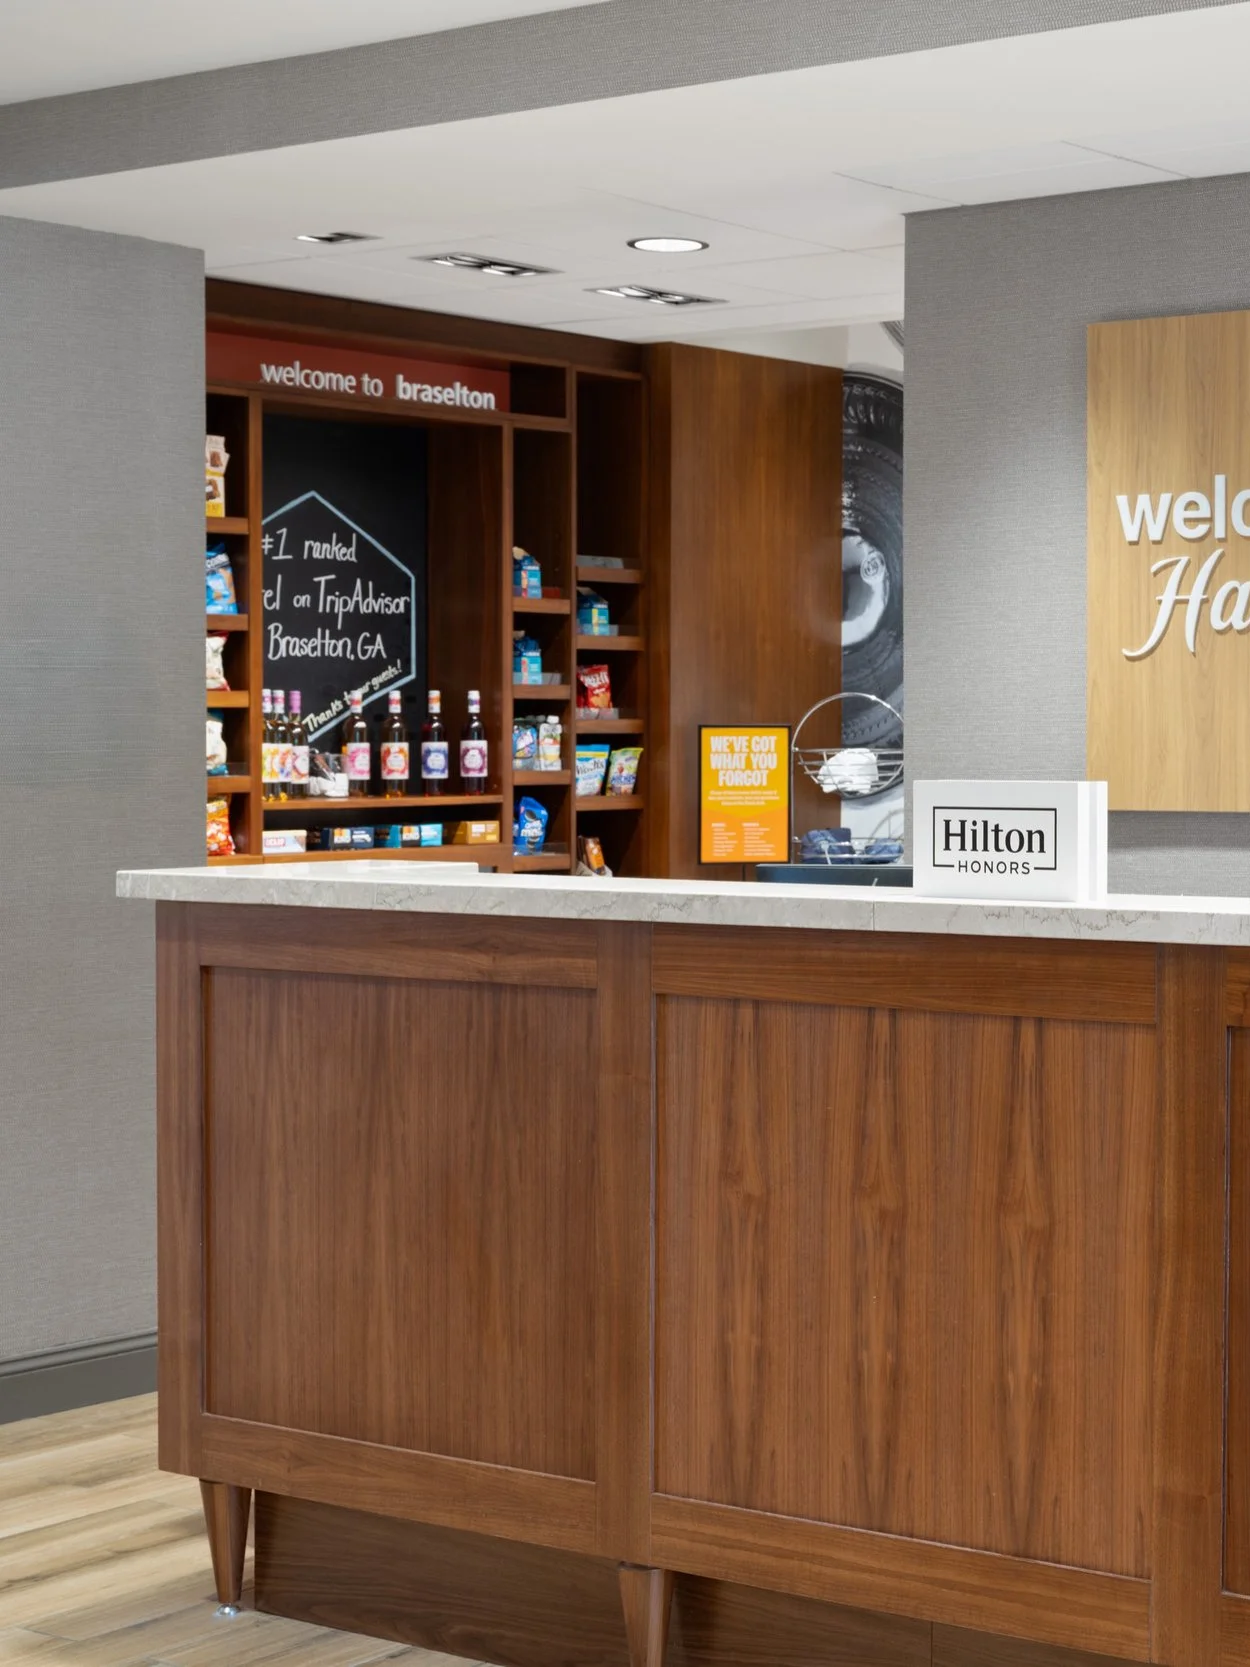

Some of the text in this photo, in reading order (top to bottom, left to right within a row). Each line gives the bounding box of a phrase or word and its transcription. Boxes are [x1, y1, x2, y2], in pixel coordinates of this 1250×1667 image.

[260, 361, 496, 411] welcome to braselton
[303, 532, 358, 563] ranked
[293, 593, 311, 608] on
[312, 574, 409, 630] TripAdvisor
[301, 699, 344, 732] Thanks
[371, 658, 402, 691] guests!
[710, 735, 777, 753] WE'VE GOT
[710, 752, 778, 770] WHAT YOU
[718, 769, 769, 787] FORGOT
[943, 819, 1047, 854] Hilton
[958, 860, 1030, 875] HONORS
